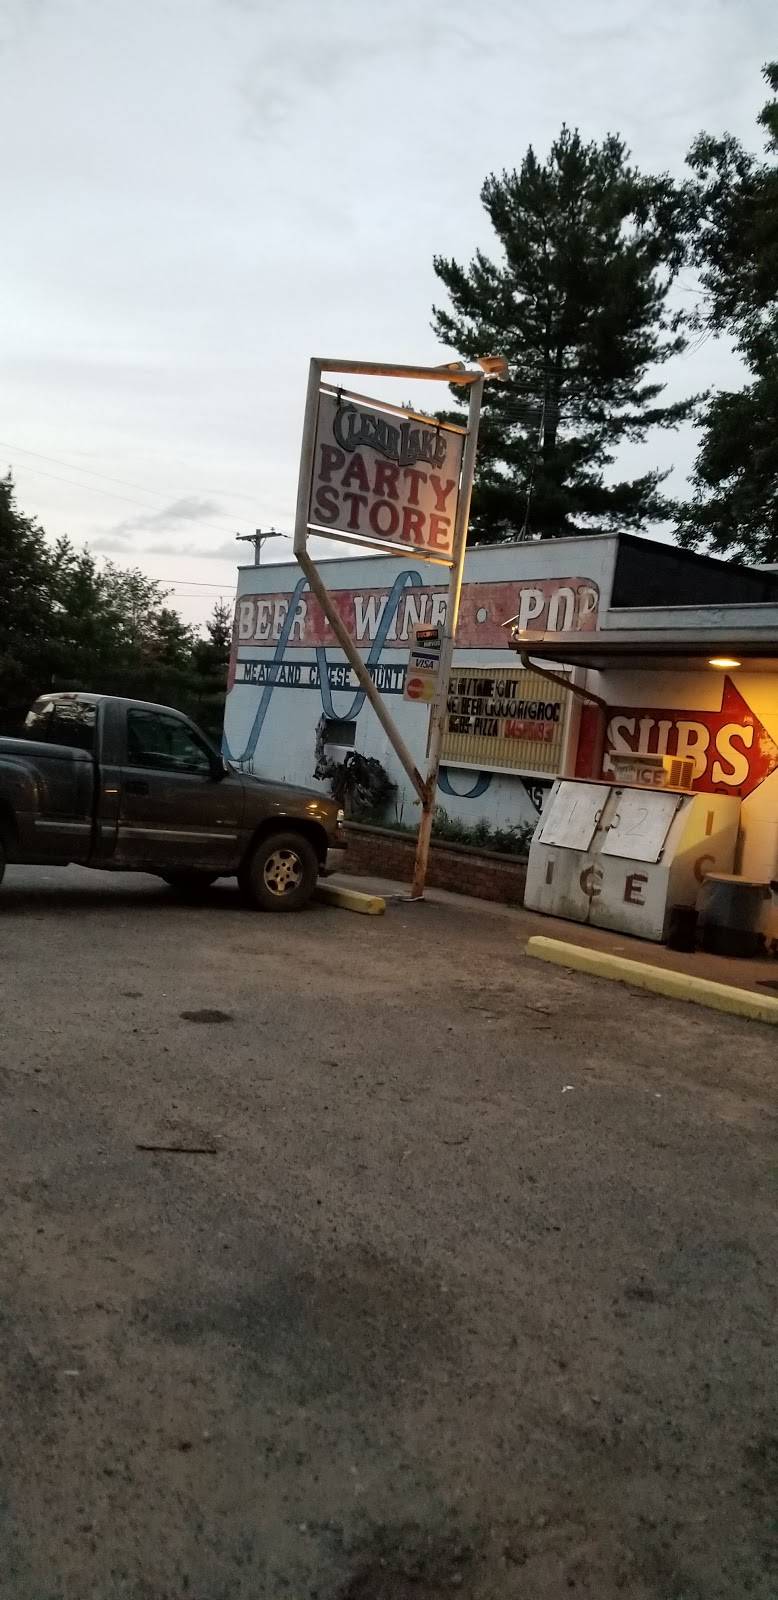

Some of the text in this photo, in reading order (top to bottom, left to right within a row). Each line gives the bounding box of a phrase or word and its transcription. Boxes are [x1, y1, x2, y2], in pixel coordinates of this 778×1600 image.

[318, 443, 456, 512] PARTY
[313, 485, 452, 550] STORE
[238, 585, 599, 641] BEER WINE POP
[244, 663, 272, 682] MEAT
[279, 664, 301, 684] AND
[415, 658, 434, 669] VISA
[602, 715, 754, 786] SUBS
[636, 767, 665, 785] ICE
[624, 807, 649, 837] 2
[545, 860, 649, 906] ICE
